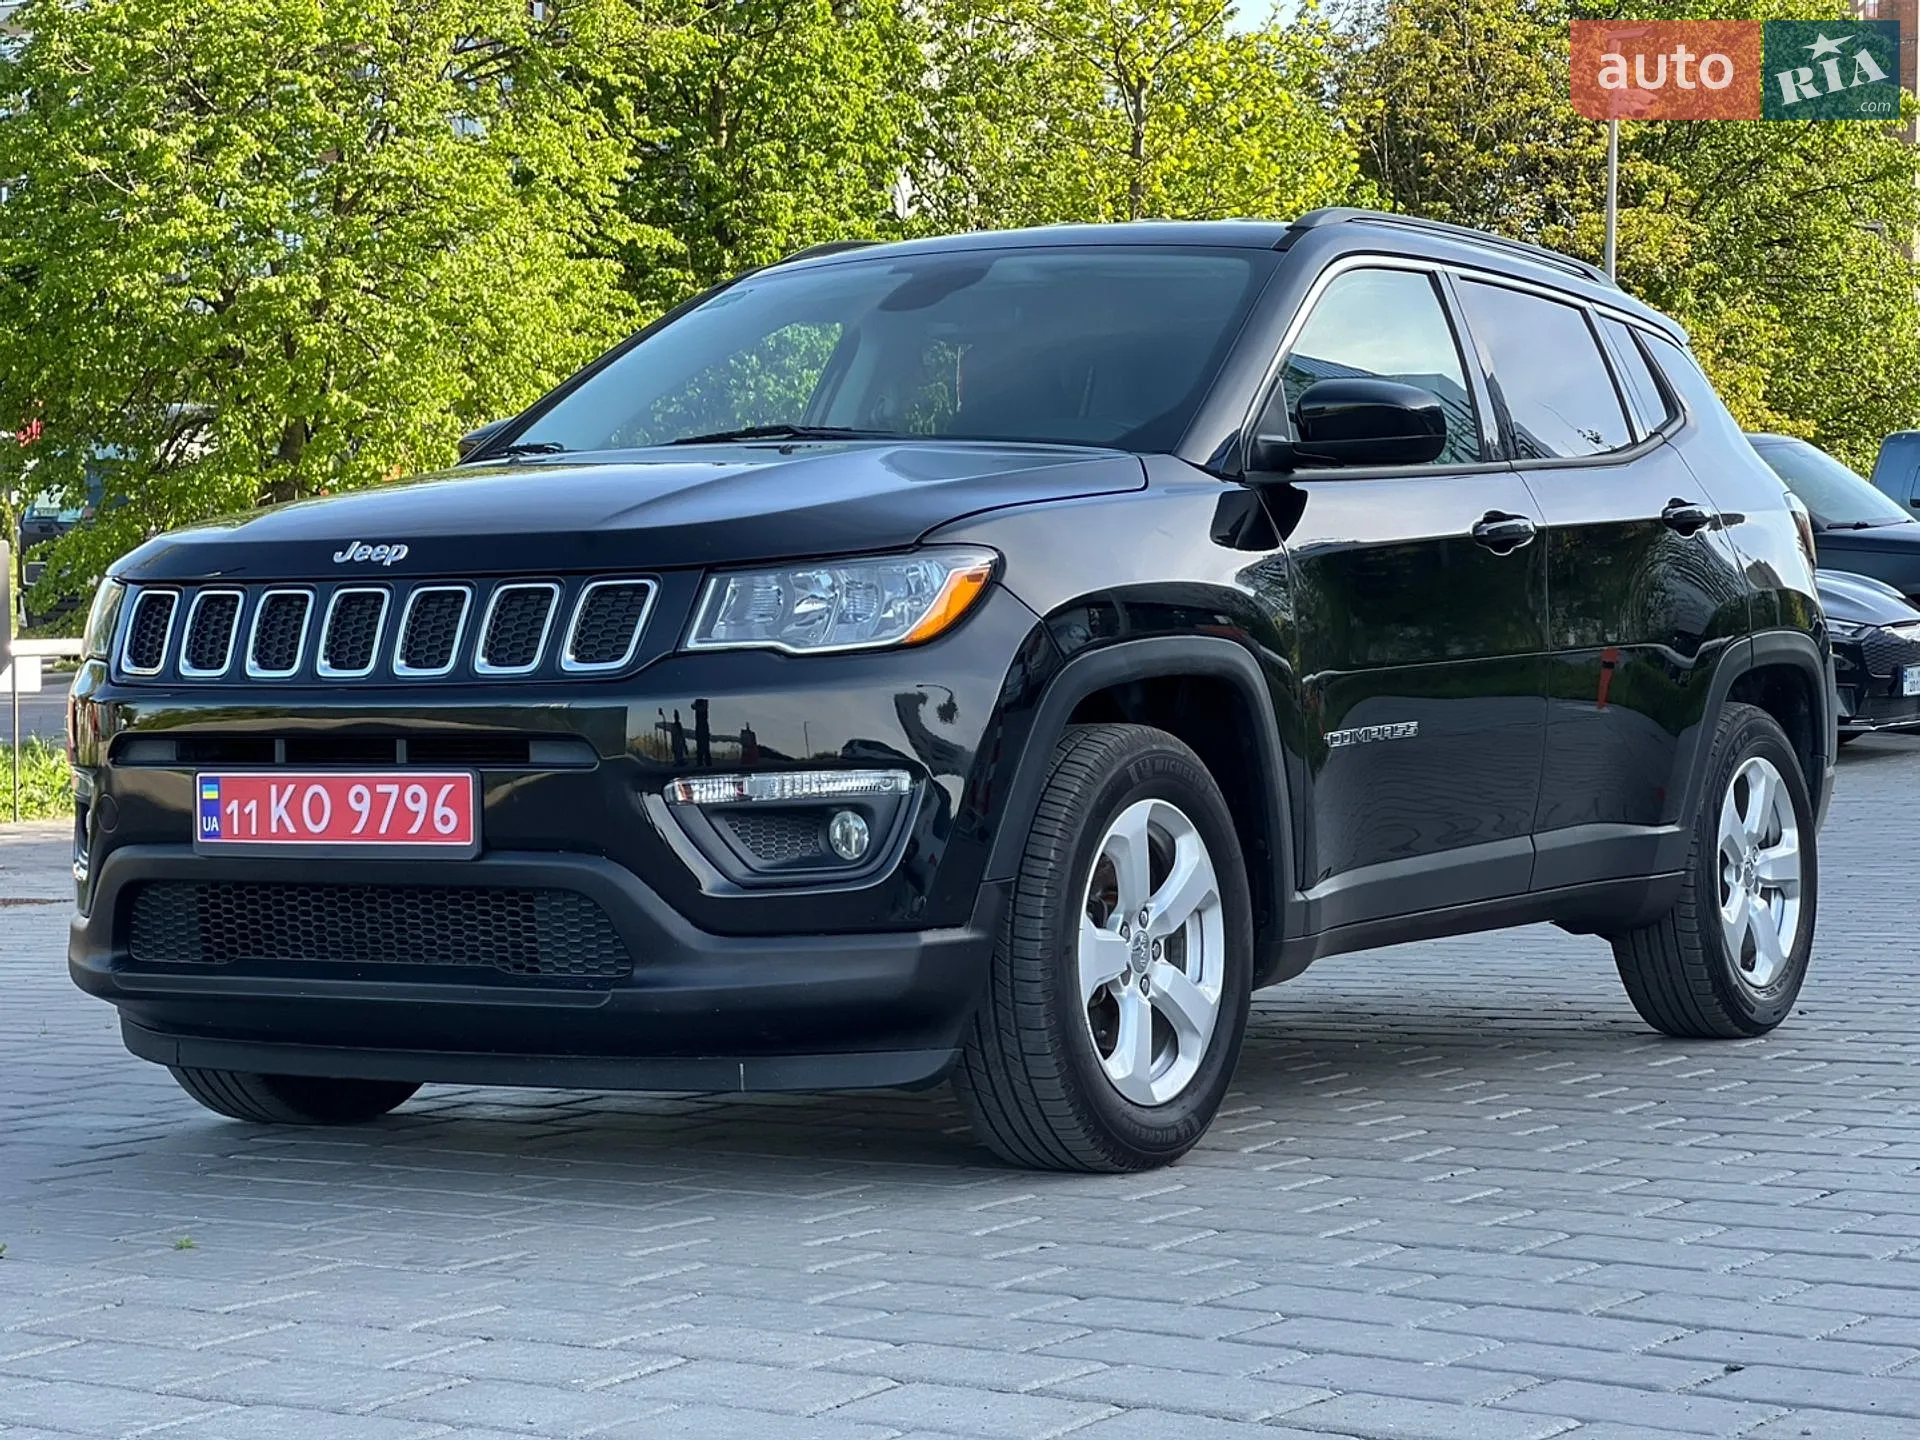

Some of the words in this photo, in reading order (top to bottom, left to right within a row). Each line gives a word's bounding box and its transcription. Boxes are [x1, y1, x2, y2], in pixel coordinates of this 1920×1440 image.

[333, 541, 408, 566] Jeep
[1323, 721, 1419, 748] COMPASS
[225, 799, 258, 835] 11
[270, 783, 332, 834] KO
[347, 783, 459, 836] 9796
[202, 815, 219, 832] UA
